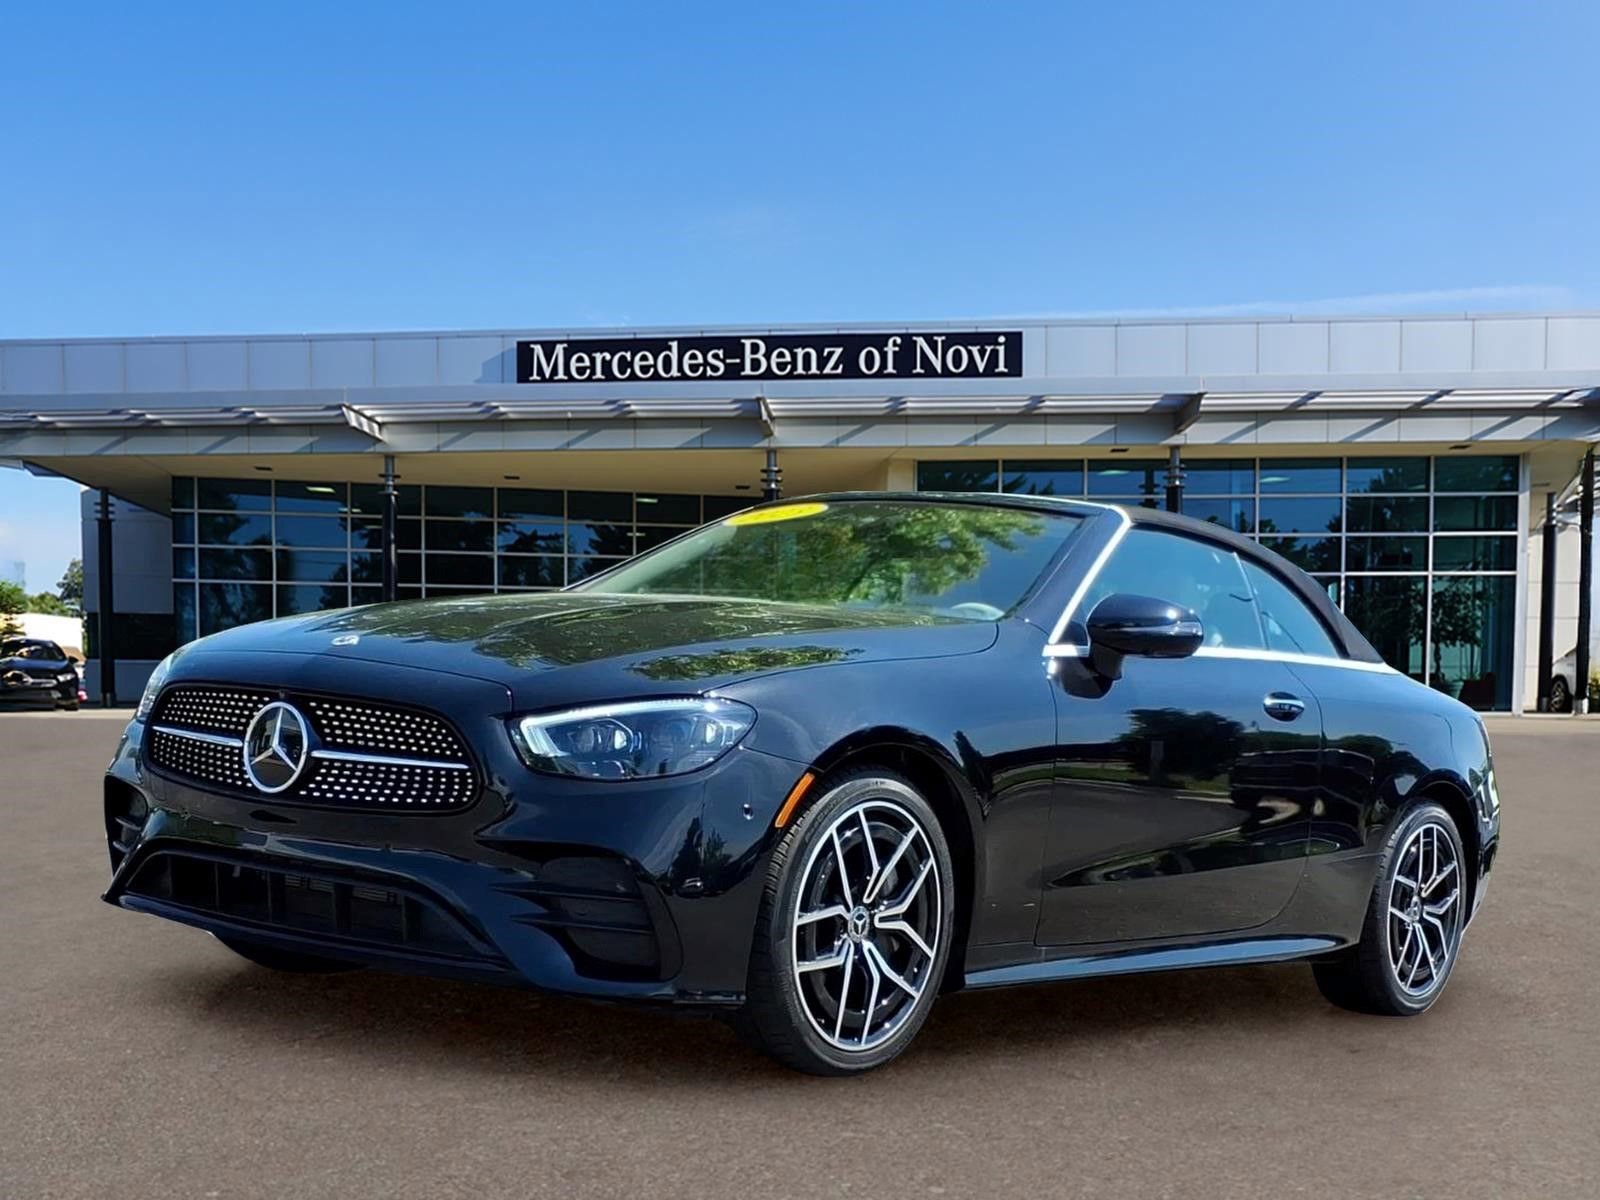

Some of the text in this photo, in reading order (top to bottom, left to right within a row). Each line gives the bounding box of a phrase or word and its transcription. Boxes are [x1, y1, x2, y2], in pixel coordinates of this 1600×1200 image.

[529, 335, 1009, 381] Mercedes-Benz of Novi
